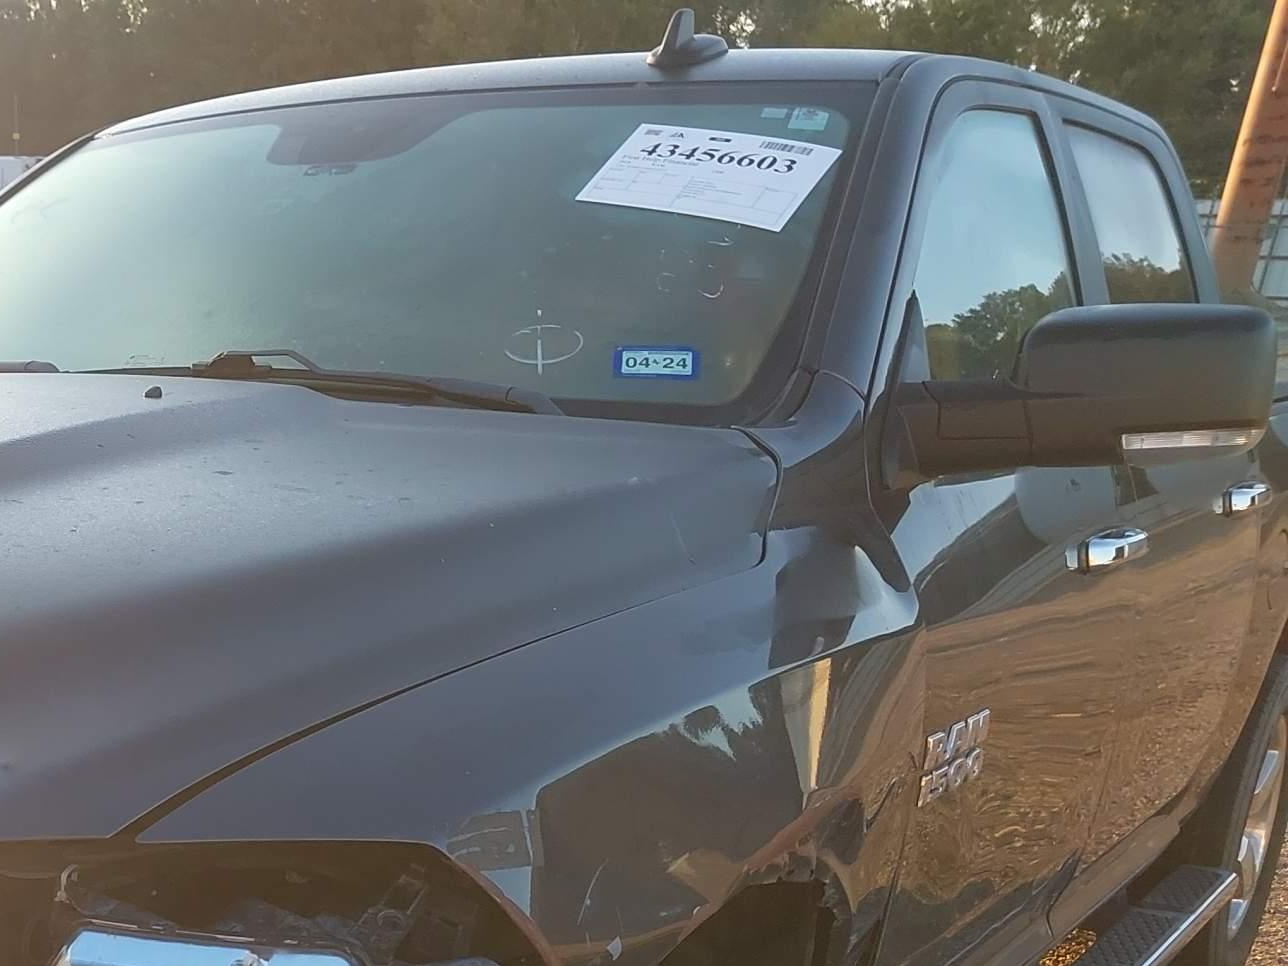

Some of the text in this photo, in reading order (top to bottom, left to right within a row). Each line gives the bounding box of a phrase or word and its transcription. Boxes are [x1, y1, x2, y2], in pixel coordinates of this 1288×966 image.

[640, 142, 797, 174] 43456603
[625, 356, 688, 369] 04 24
[922, 706, 991, 771] RAM
[916, 746, 984, 808] 1500
